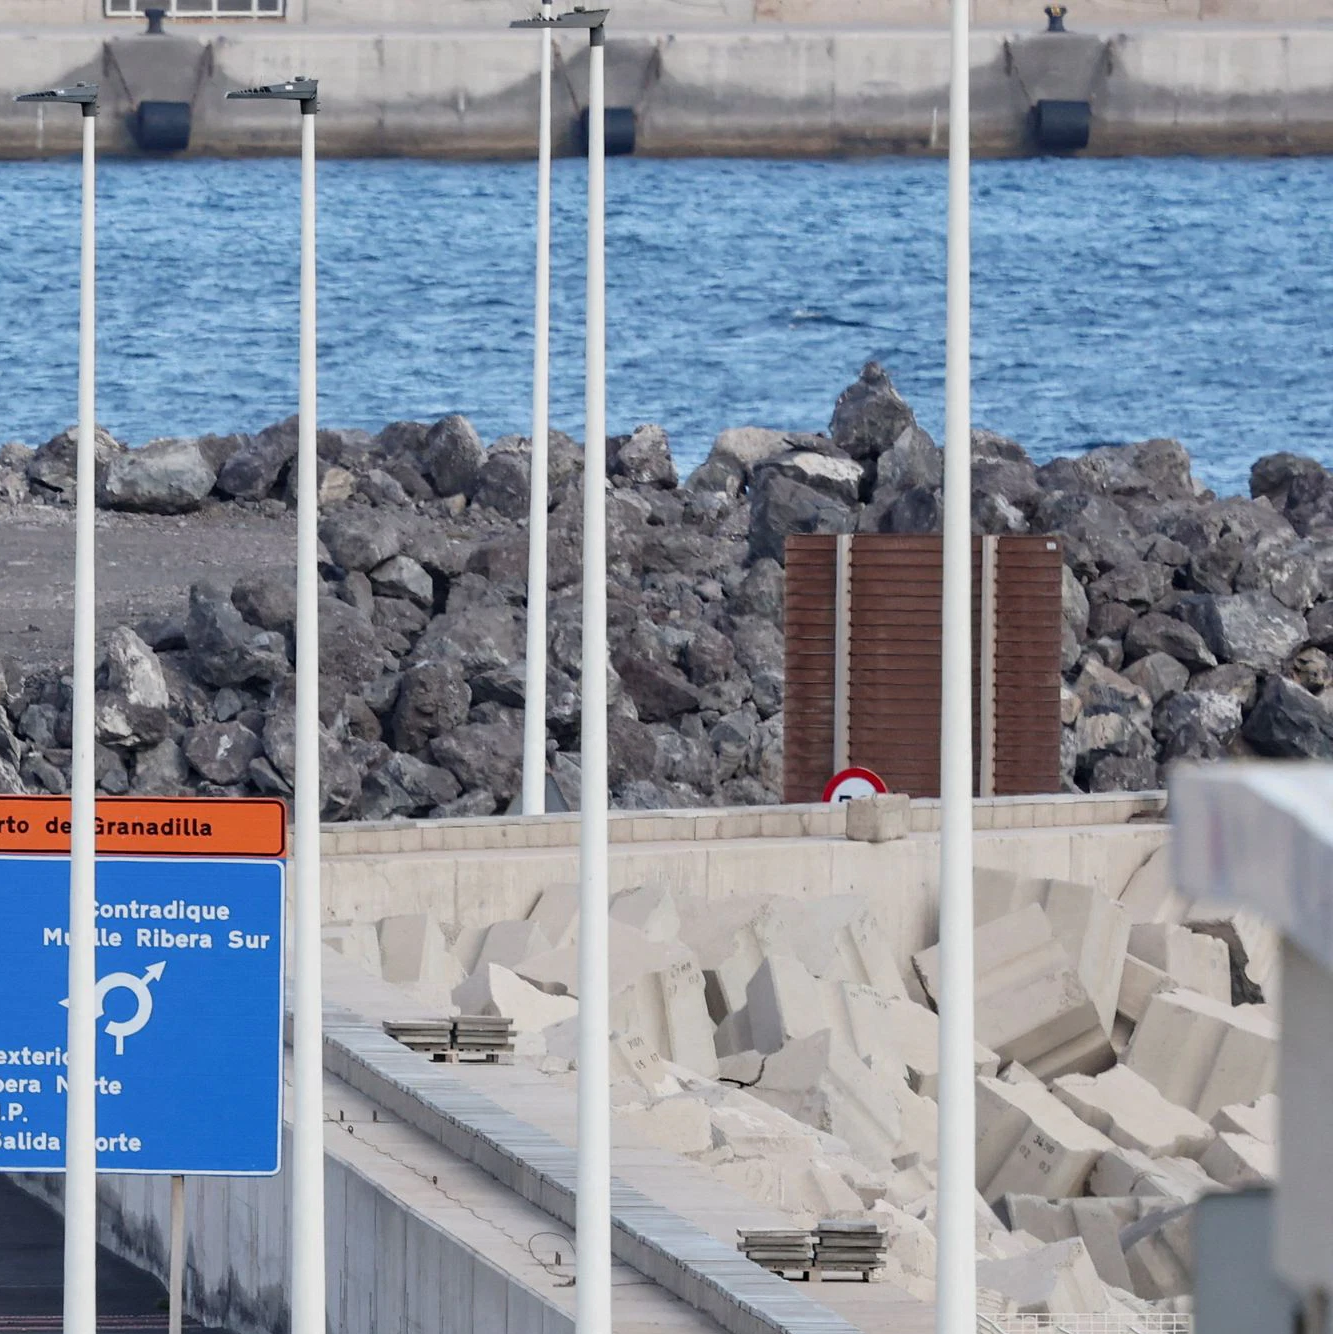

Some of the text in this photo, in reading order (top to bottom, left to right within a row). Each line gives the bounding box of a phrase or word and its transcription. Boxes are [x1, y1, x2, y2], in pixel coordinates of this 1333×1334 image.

[45, 816, 71, 834] de
[136, 928, 213, 949] Ribera
[228, 930, 270, 949] Sur
[95, 1132, 142, 1152] orte
